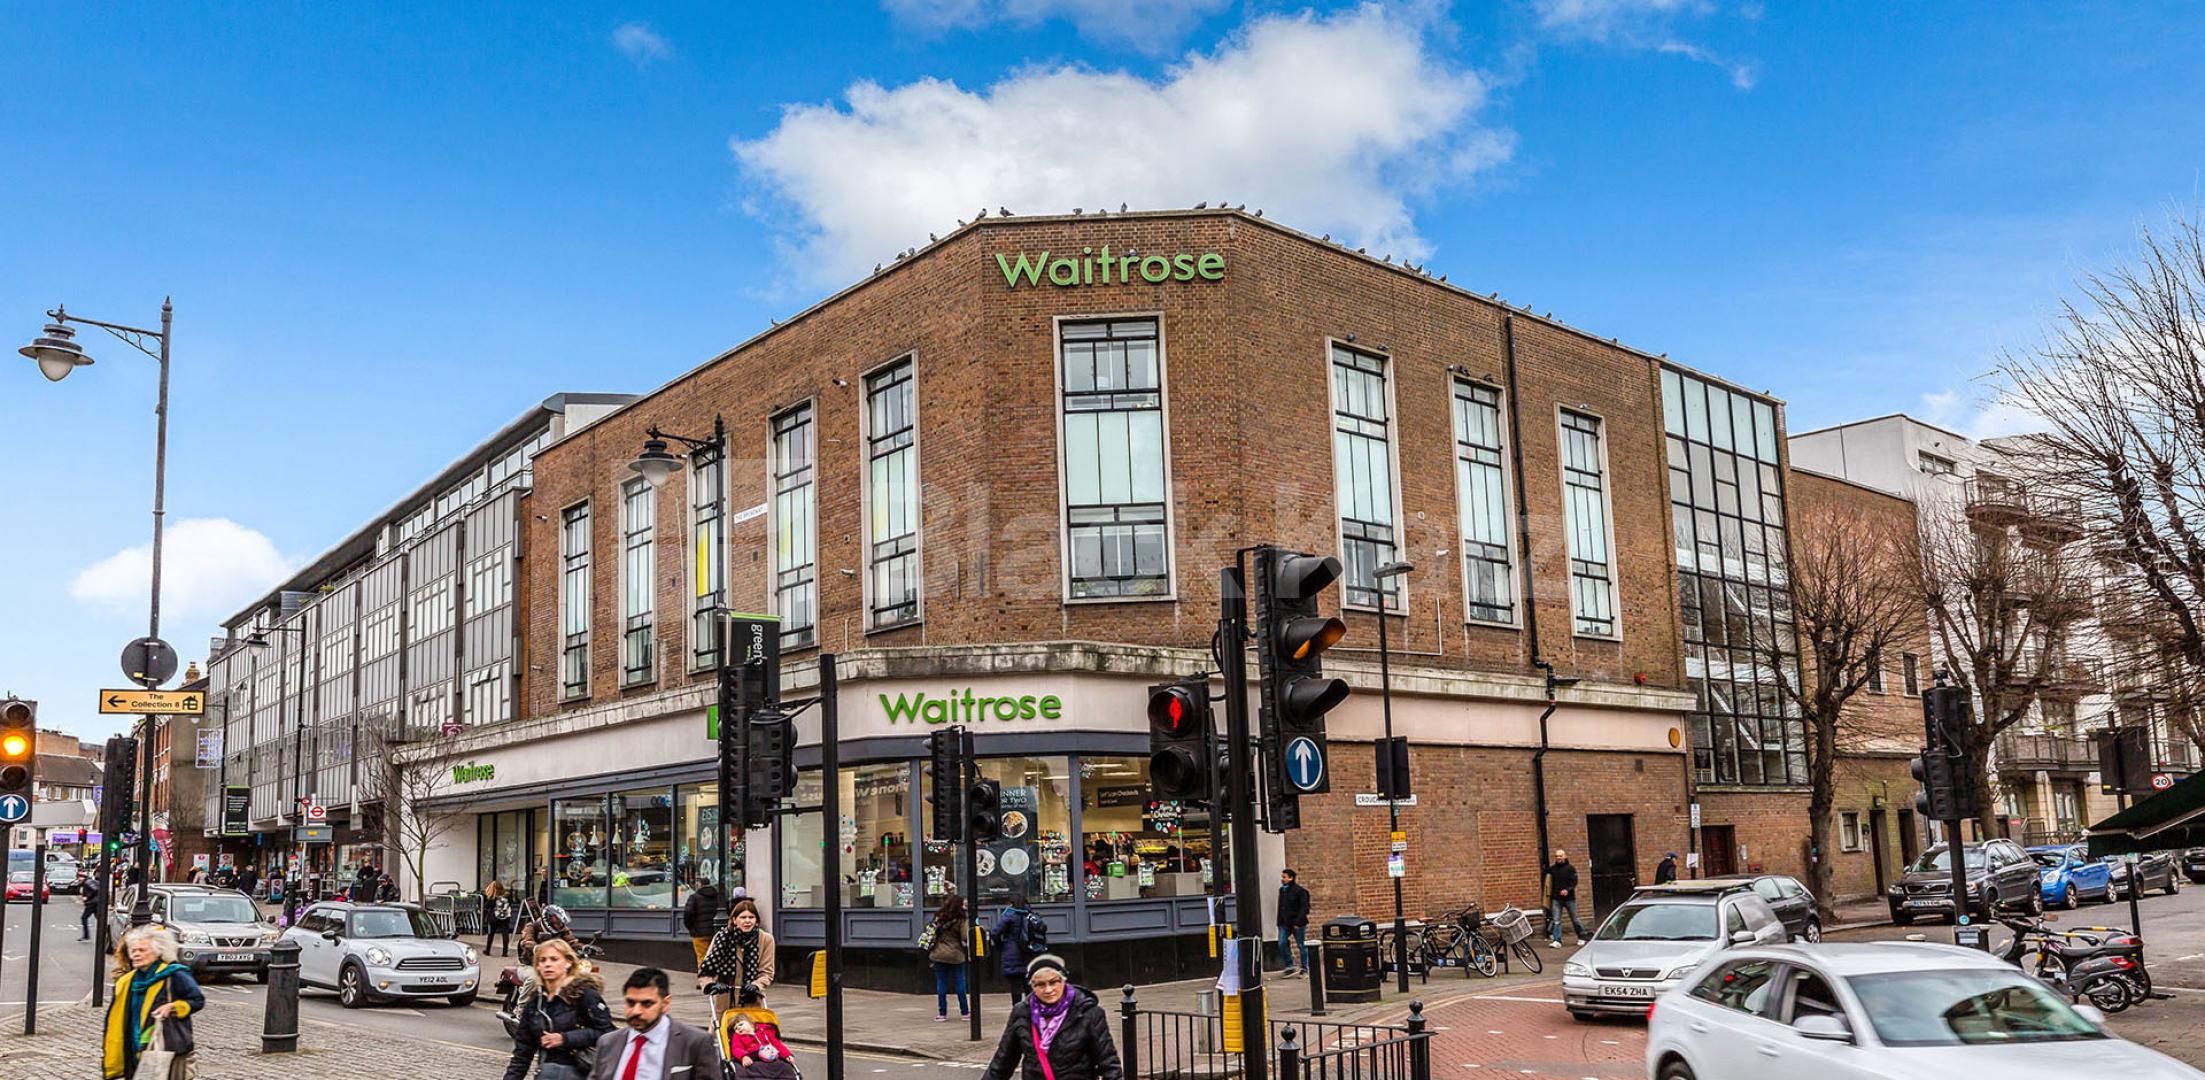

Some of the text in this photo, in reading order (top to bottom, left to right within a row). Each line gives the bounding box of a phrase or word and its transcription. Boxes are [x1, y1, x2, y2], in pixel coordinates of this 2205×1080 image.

[995, 244, 1225, 288] Waitrose
[131, 700, 173, 708] Collection
[879, 687, 1062, 724] Waitrose
[452, 760, 495, 784] Waitrose
[2154, 777, 2168, 786] 20
[1604, 986, 1648, 996] EK54 ZHA
